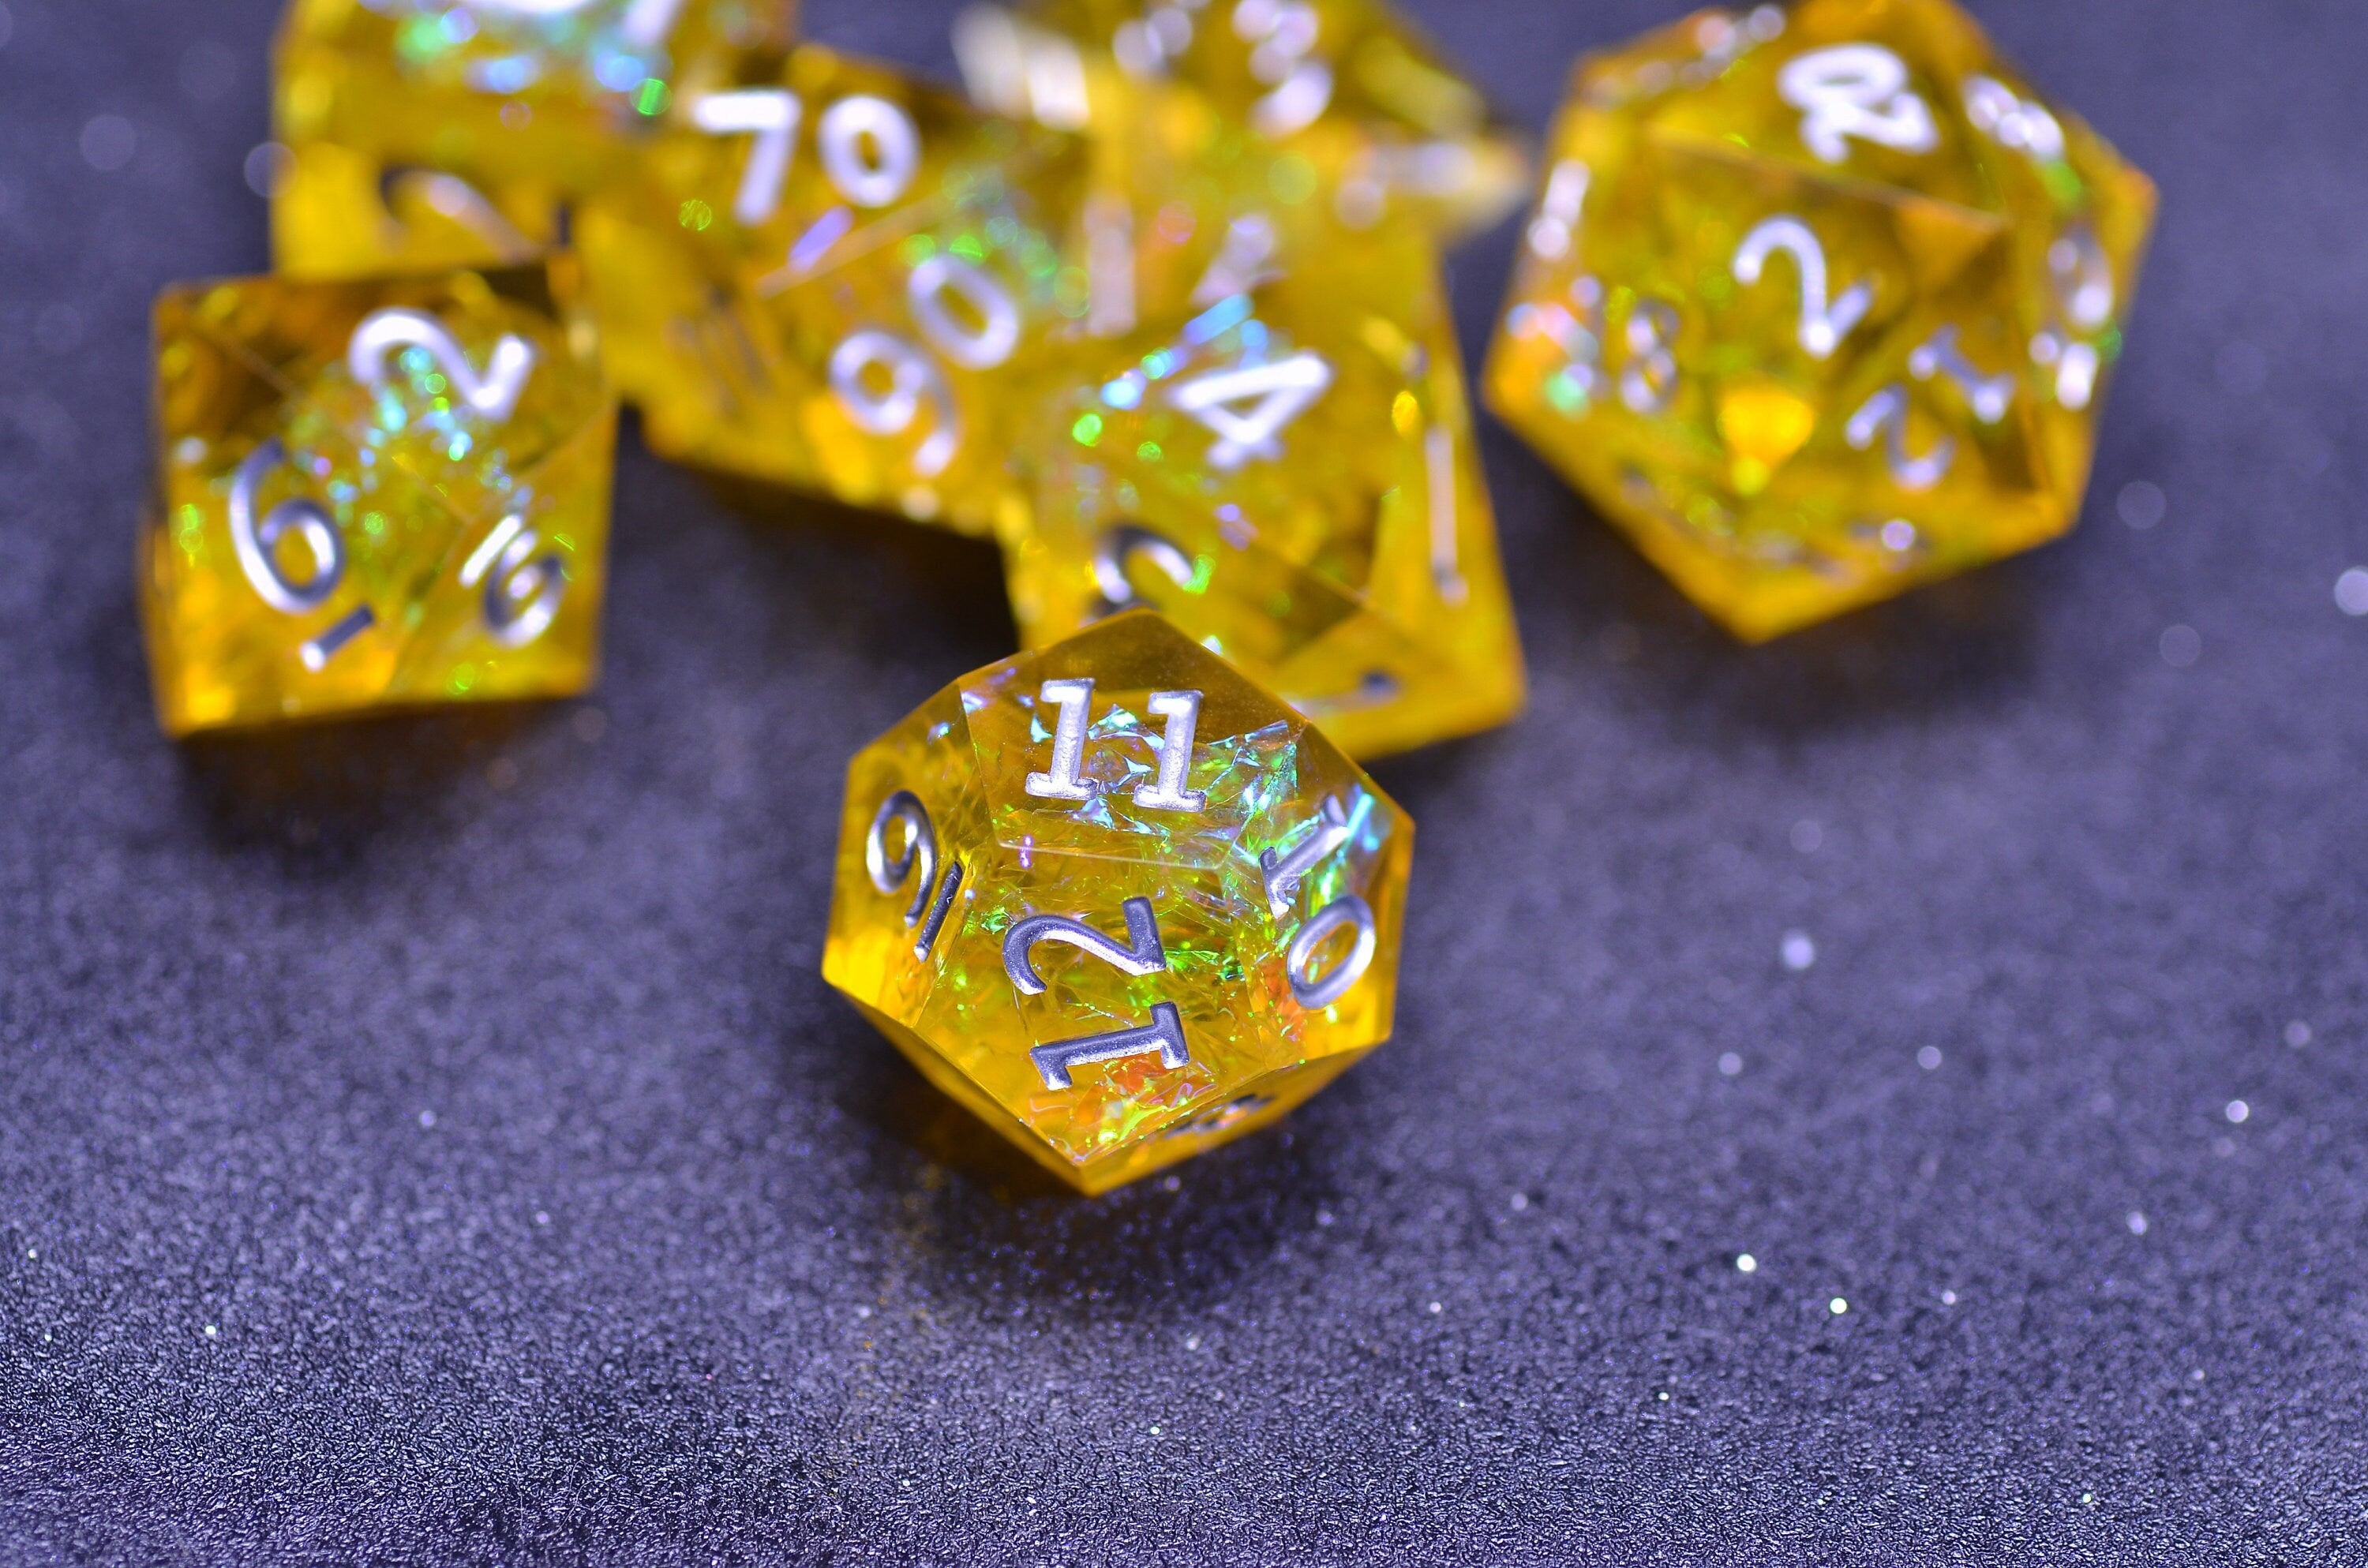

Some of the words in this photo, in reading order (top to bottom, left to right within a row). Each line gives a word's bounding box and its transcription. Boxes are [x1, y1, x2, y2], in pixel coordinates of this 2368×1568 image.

[691, 88, 920, 224] 70
[1778, 41, 1940, 164] 20
[1732, 215, 1877, 357] 2
[347, 308, 533, 418] 2
[829, 254, 1018, 477] 90
[1165, 347, 1334, 469] 4
[1845, 324, 2018, 493] 12
[229, 438, 345, 616] 6
[1025, 677, 1207, 813] 11
[866, 790, 937, 929] 9
[1259, 794, 1376, 1009] 10
[1002, 896, 1190, 1091] 12
